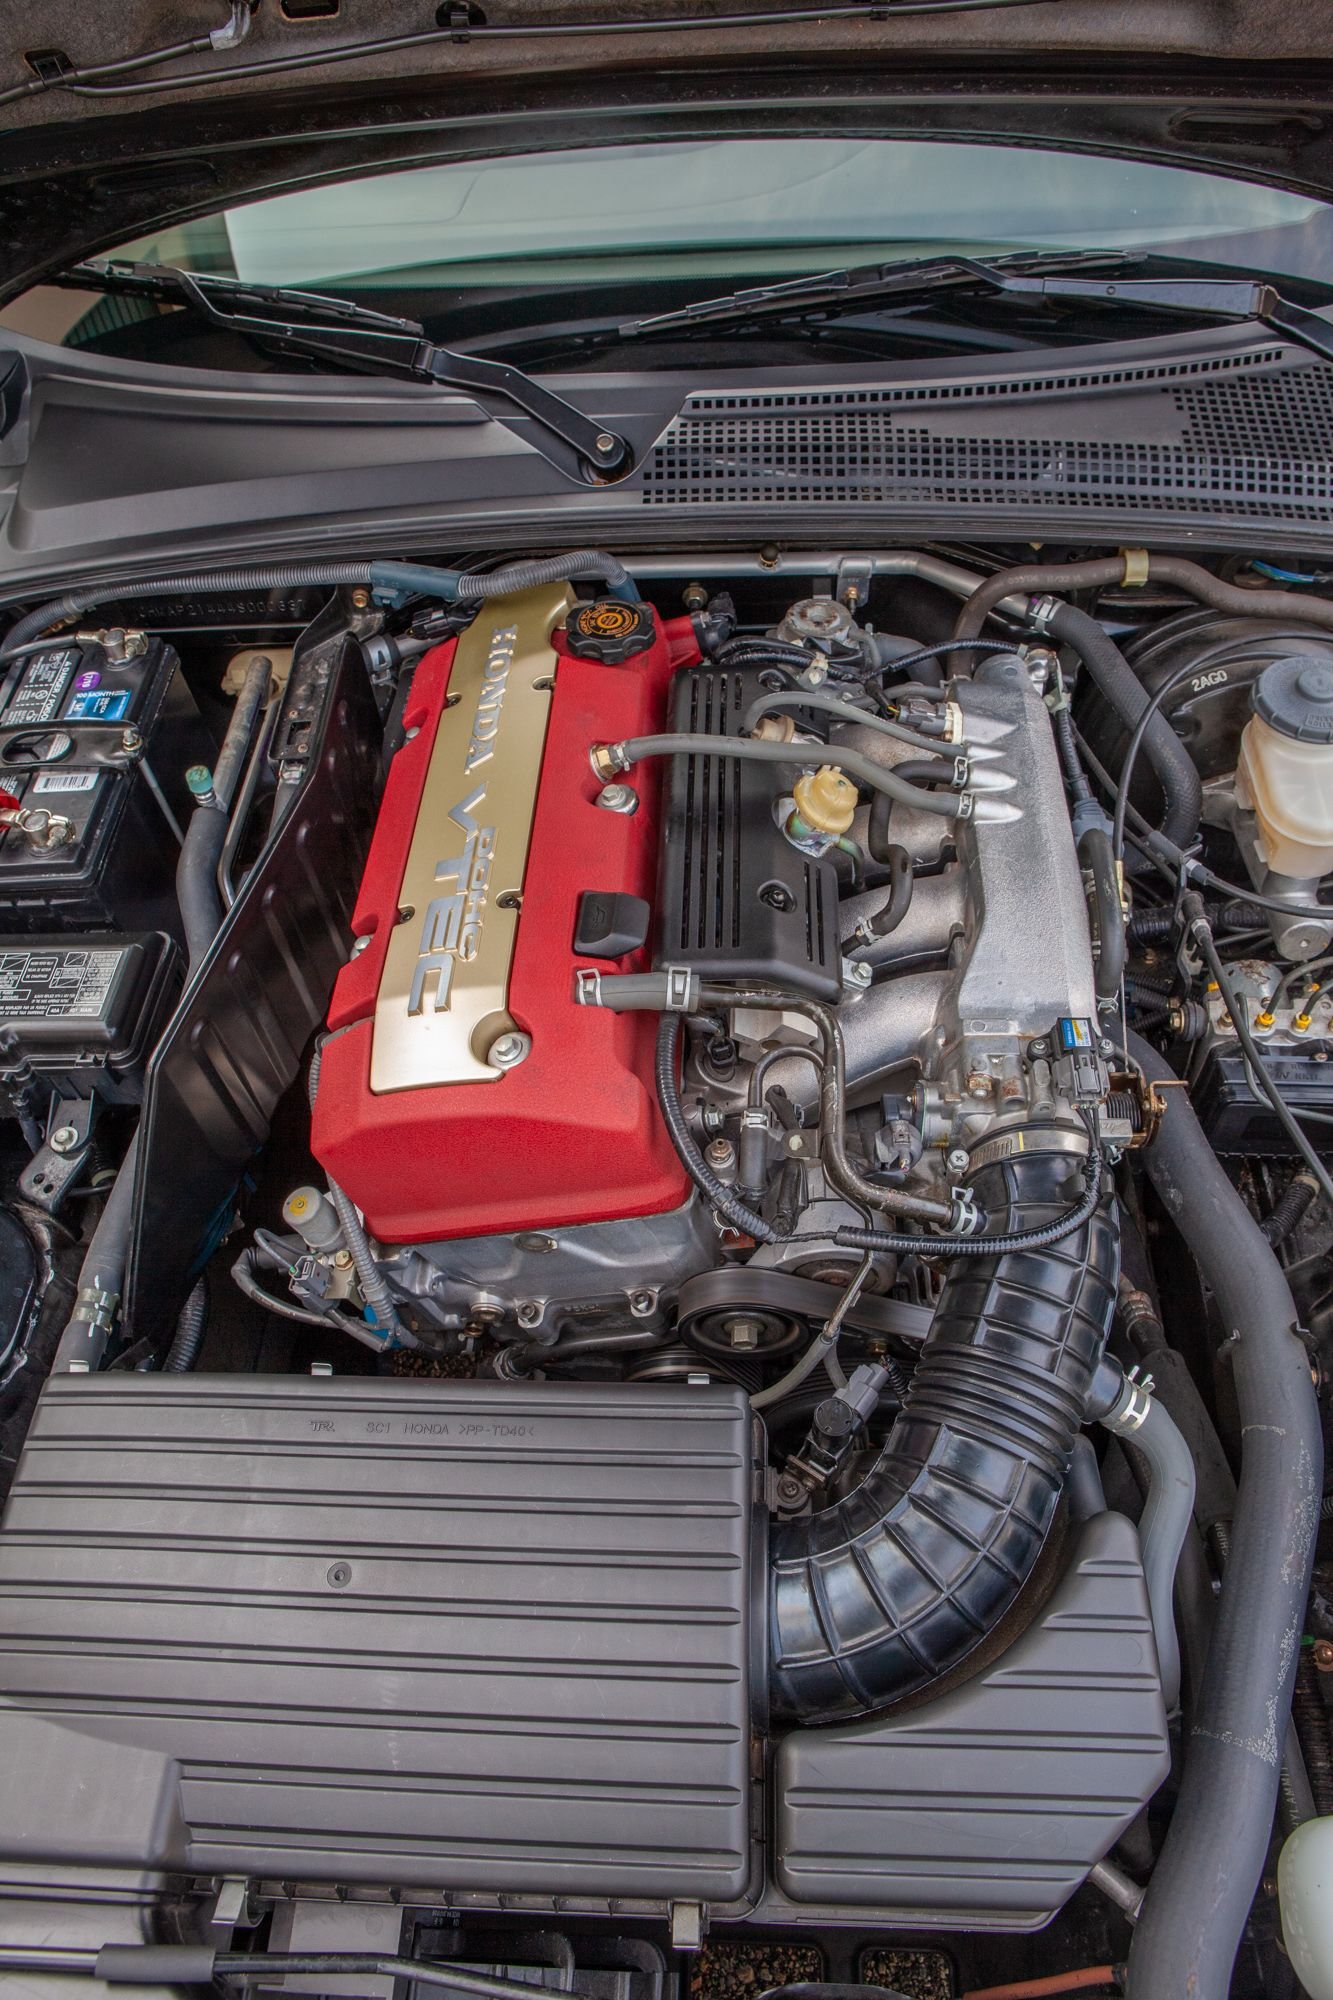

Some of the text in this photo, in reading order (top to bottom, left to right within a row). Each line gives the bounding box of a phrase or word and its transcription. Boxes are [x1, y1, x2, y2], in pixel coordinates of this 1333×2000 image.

[464, 624, 519, 776] HONDA
[408, 781, 490, 1018] VTEC
[459, 825, 498, 962] DOHC
[403, 1422, 449, 1436] HONDA
